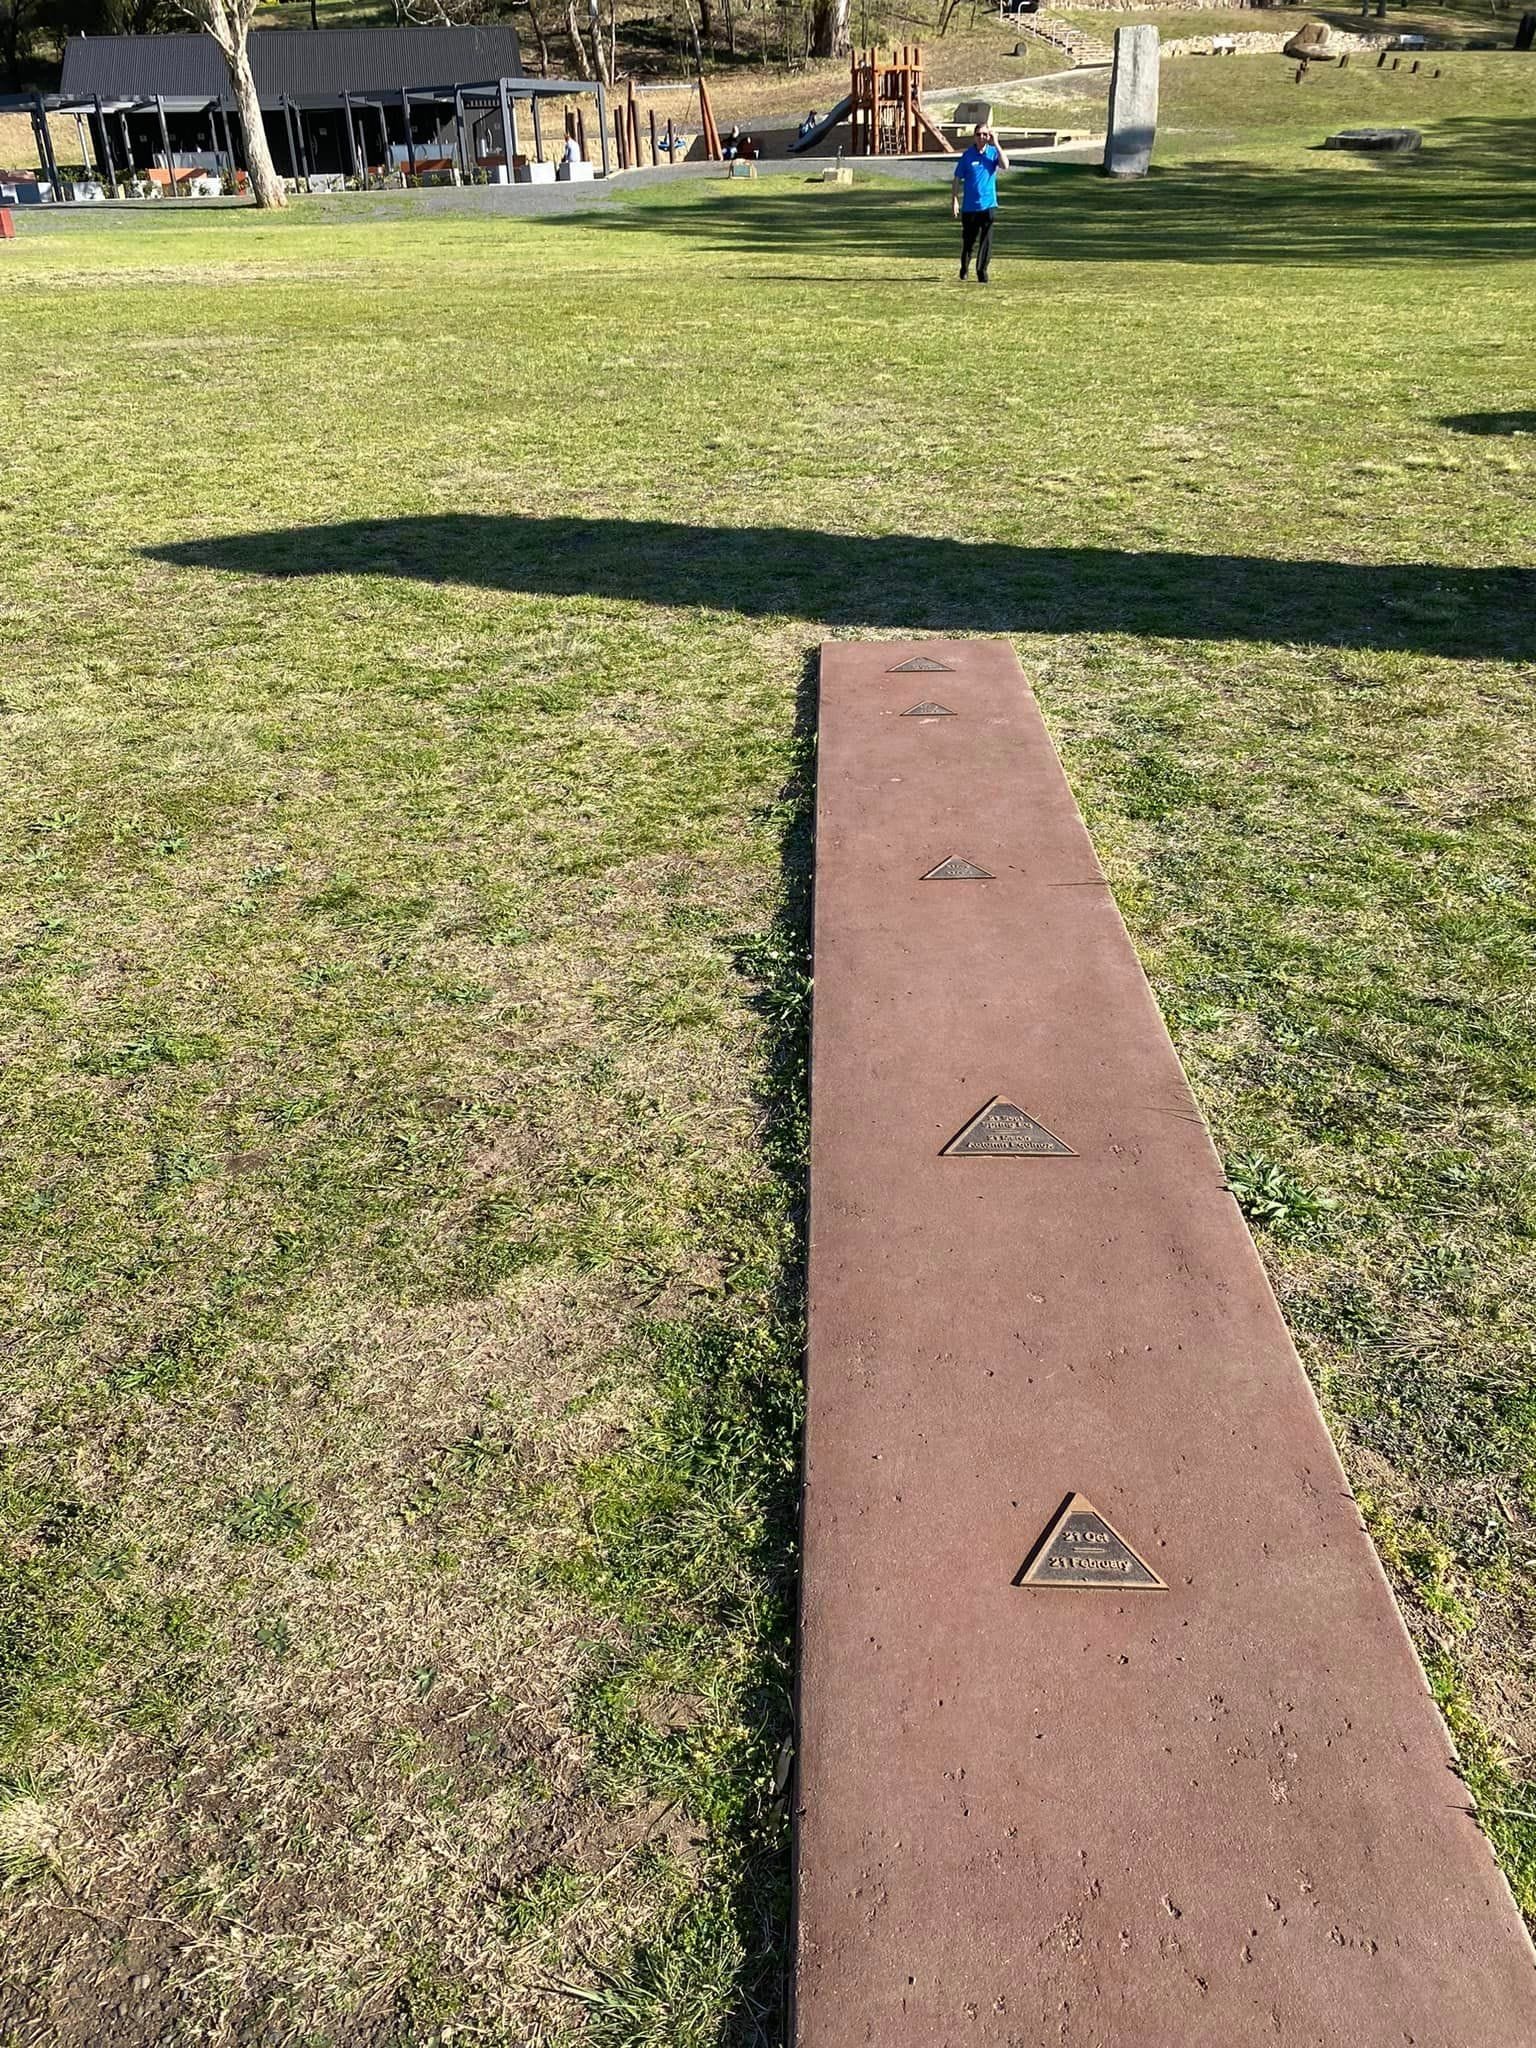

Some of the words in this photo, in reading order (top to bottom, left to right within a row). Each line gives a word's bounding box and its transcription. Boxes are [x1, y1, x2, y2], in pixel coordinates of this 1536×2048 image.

[1062, 1531, 1081, 1542] 21
[1082, 1531, 1109, 1544] Oct
[1048, 1557, 1068, 1569] 21
[1069, 1557, 1132, 1572] February
